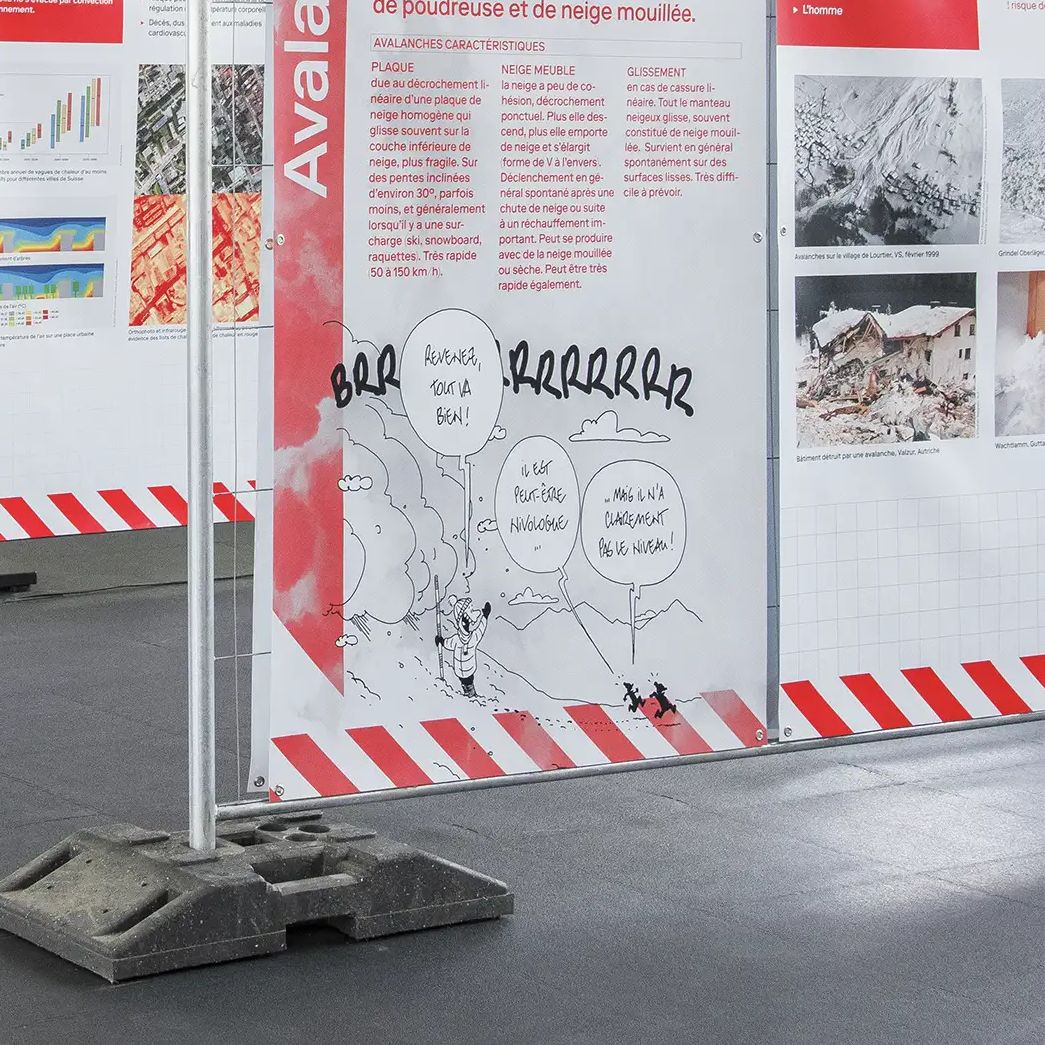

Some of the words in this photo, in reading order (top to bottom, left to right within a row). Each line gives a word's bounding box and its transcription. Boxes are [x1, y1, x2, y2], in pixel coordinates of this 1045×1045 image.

[508, 0, 528, 18] et
[532, 0, 556, 19] de
[561, 0, 612, 25] neige
[617, 3, 695, 22] mouillée.
[373, 37, 443, 50] AVALANCHES
[444, 38, 545, 52] CARACTÉRISTIQUES
[371, 61, 414, 73] PLAQUE
[501, 64, 531, 75] NEIGE
[534, 64, 575, 76] MEUBLE
[626, 66, 686, 77] GLISSEMENT
[501, 95, 534, 107] hésion,
[535, 95, 605, 107] décrochement
[370, 109, 399, 122] neige
[400, 109, 454, 123] homogène
[455, 110, 471, 123] qui
[626, 113, 661, 125] neigeux
[662, 112, 691, 125] glisse,
[692, 113, 730, 123] souvent
[369, 140, 407, 152] couche
[408, 140, 457, 152] inférieure
[458, 141, 471, 152] de
[623, 156, 691, 169] spontanément
[692, 158, 708, 167] sur
[709, 157, 727, 167] des
[368, 172, 387, 183] des
[389, 173, 424, 185] pentes
[426, 172, 470, 183] inclinées
[623, 187, 639, 197] cile
[641, 187, 647, 197] à
[648, 187, 682, 199] prévoir.
[843, 252, 861, 260] village
[905, 250, 925, 258] février
[926, 250, 939, 258] 1999
[498, 279, 528, 293] rapide
[529, 279, 582, 292] également.
